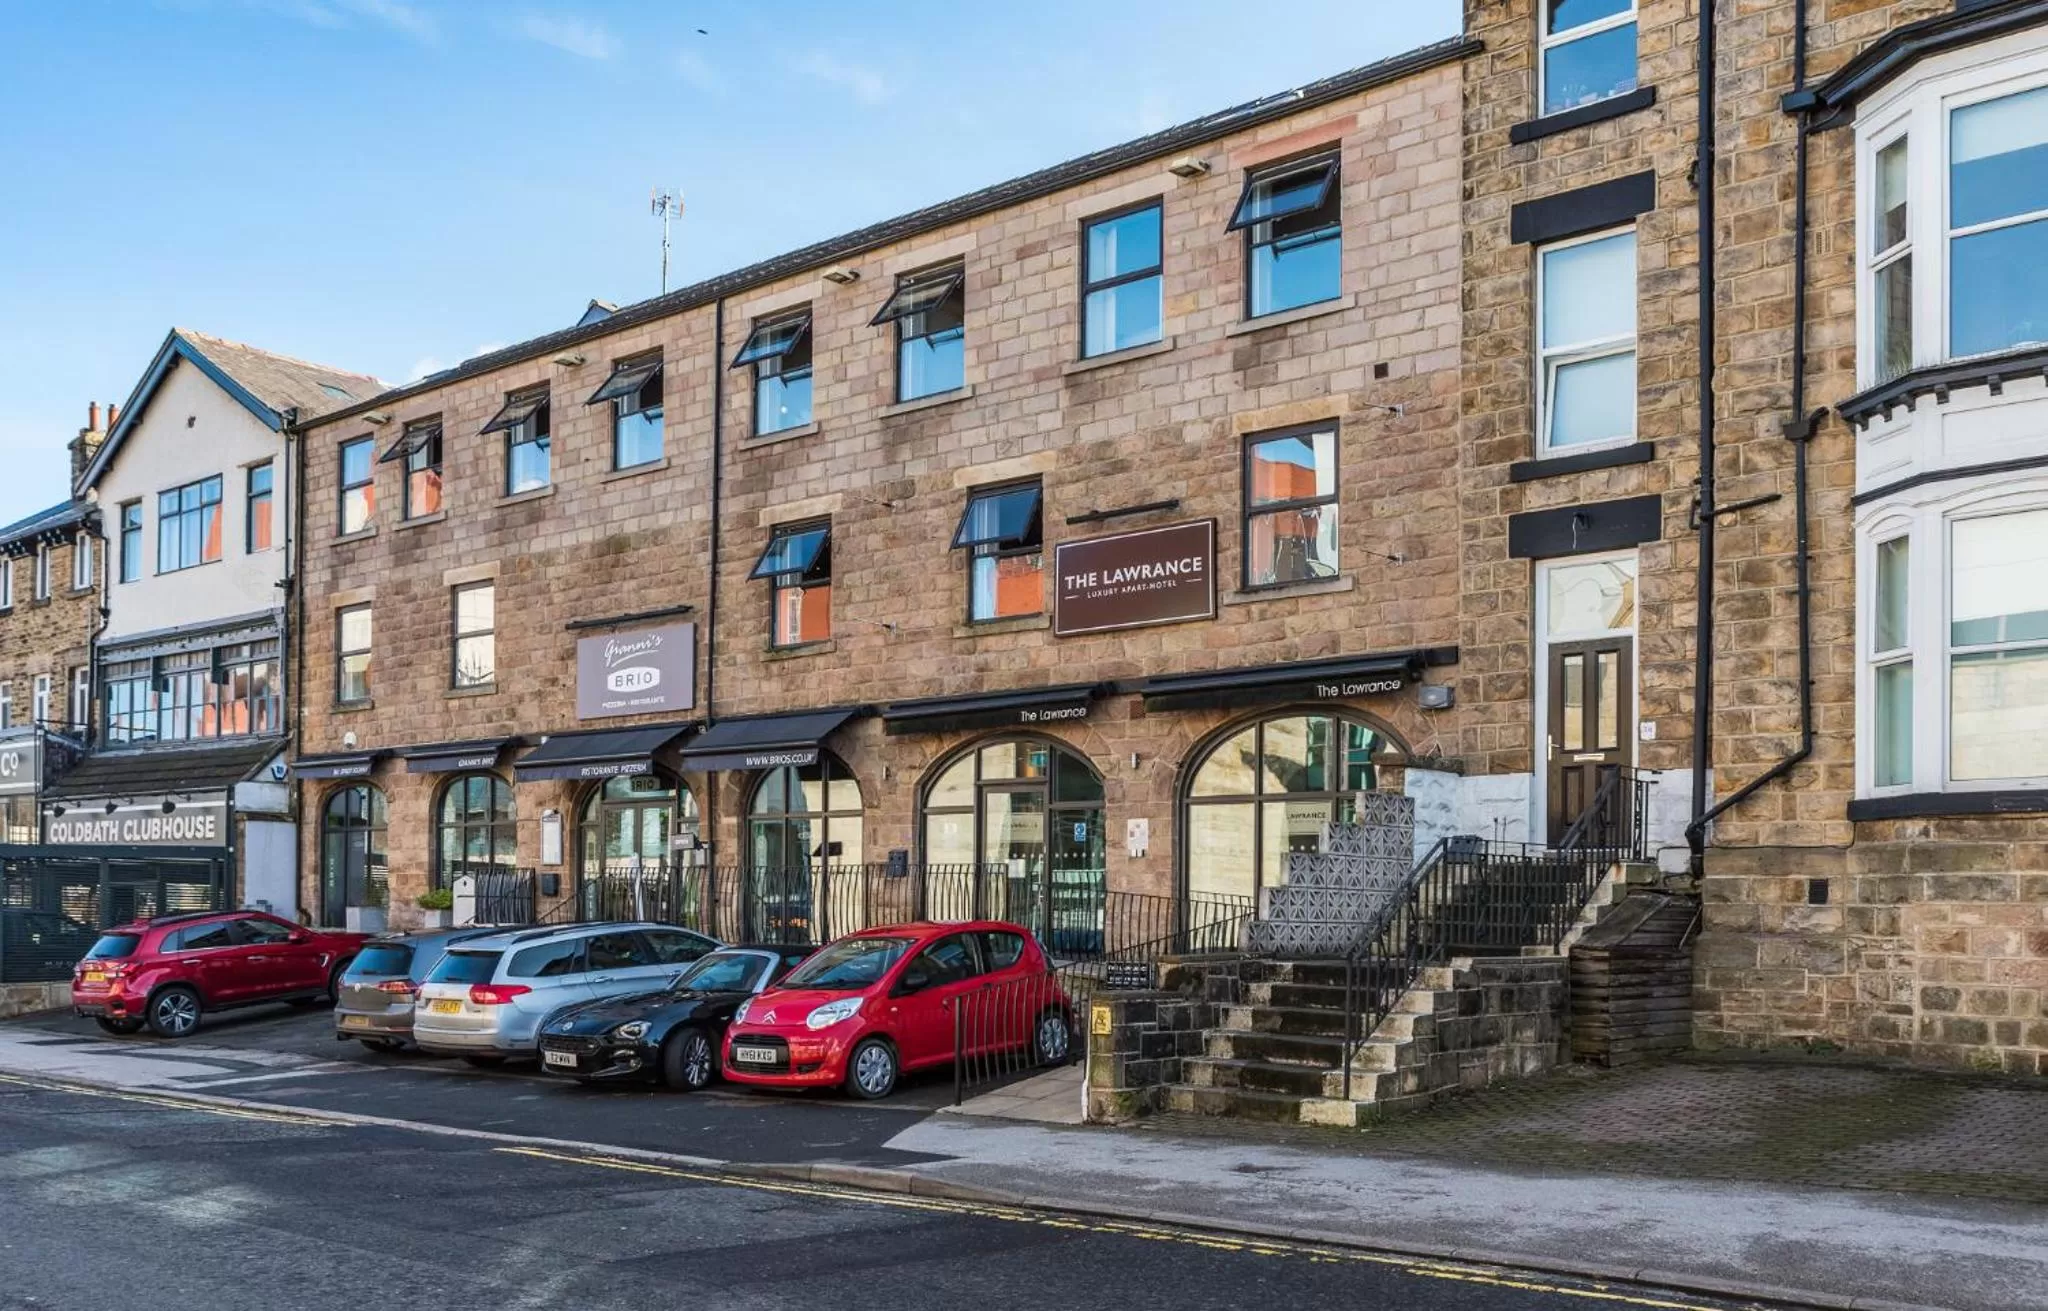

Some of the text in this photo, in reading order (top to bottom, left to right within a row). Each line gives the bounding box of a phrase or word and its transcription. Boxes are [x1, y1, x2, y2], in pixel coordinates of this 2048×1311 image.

[1064, 556, 1202, 590] THE LAWRANCE
[1086, 588, 1118, 599] LUXURY
[604, 633, 663, 668] Gianni's
[614, 671, 653, 688] BRIO
[1316, 679, 1401, 698] The Lawrance
[1020, 707, 1087, 722] The Lawrance
[581, 765, 619, 777] RISTORANTE
[50, 814, 216, 843] COLDBATH CLUBHOUSE
